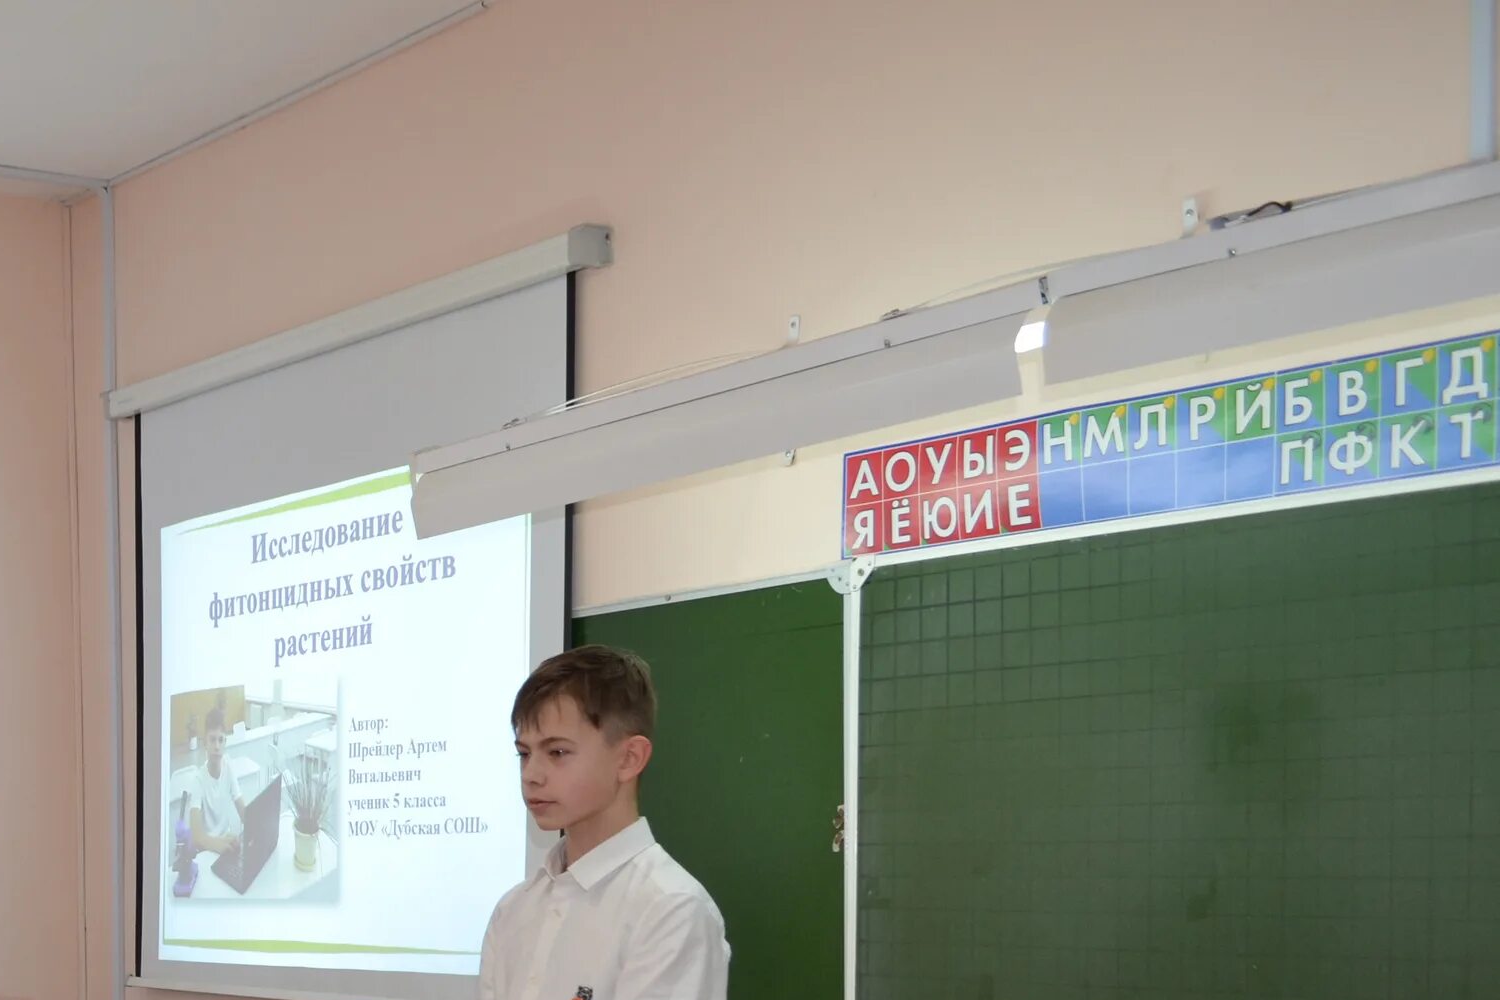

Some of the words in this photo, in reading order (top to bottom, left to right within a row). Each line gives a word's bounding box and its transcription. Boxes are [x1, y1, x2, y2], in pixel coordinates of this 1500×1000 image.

[250, 510, 404, 564] Исследование
[208, 573, 354, 628] фитонцидных
[361, 553, 457, 593] свойств
[274, 614, 373, 668] растений
[348, 717, 389, 735] Автор:
[348, 740, 404, 762] Шрейдер
[407, 737, 447, 759] Артем
[348, 768, 422, 785] Витальевич
[347, 797, 390, 816] ученик
[392, 792, 400, 809] 5
[403, 795, 447, 809] класса
[347, 819, 378, 838] МОУ
